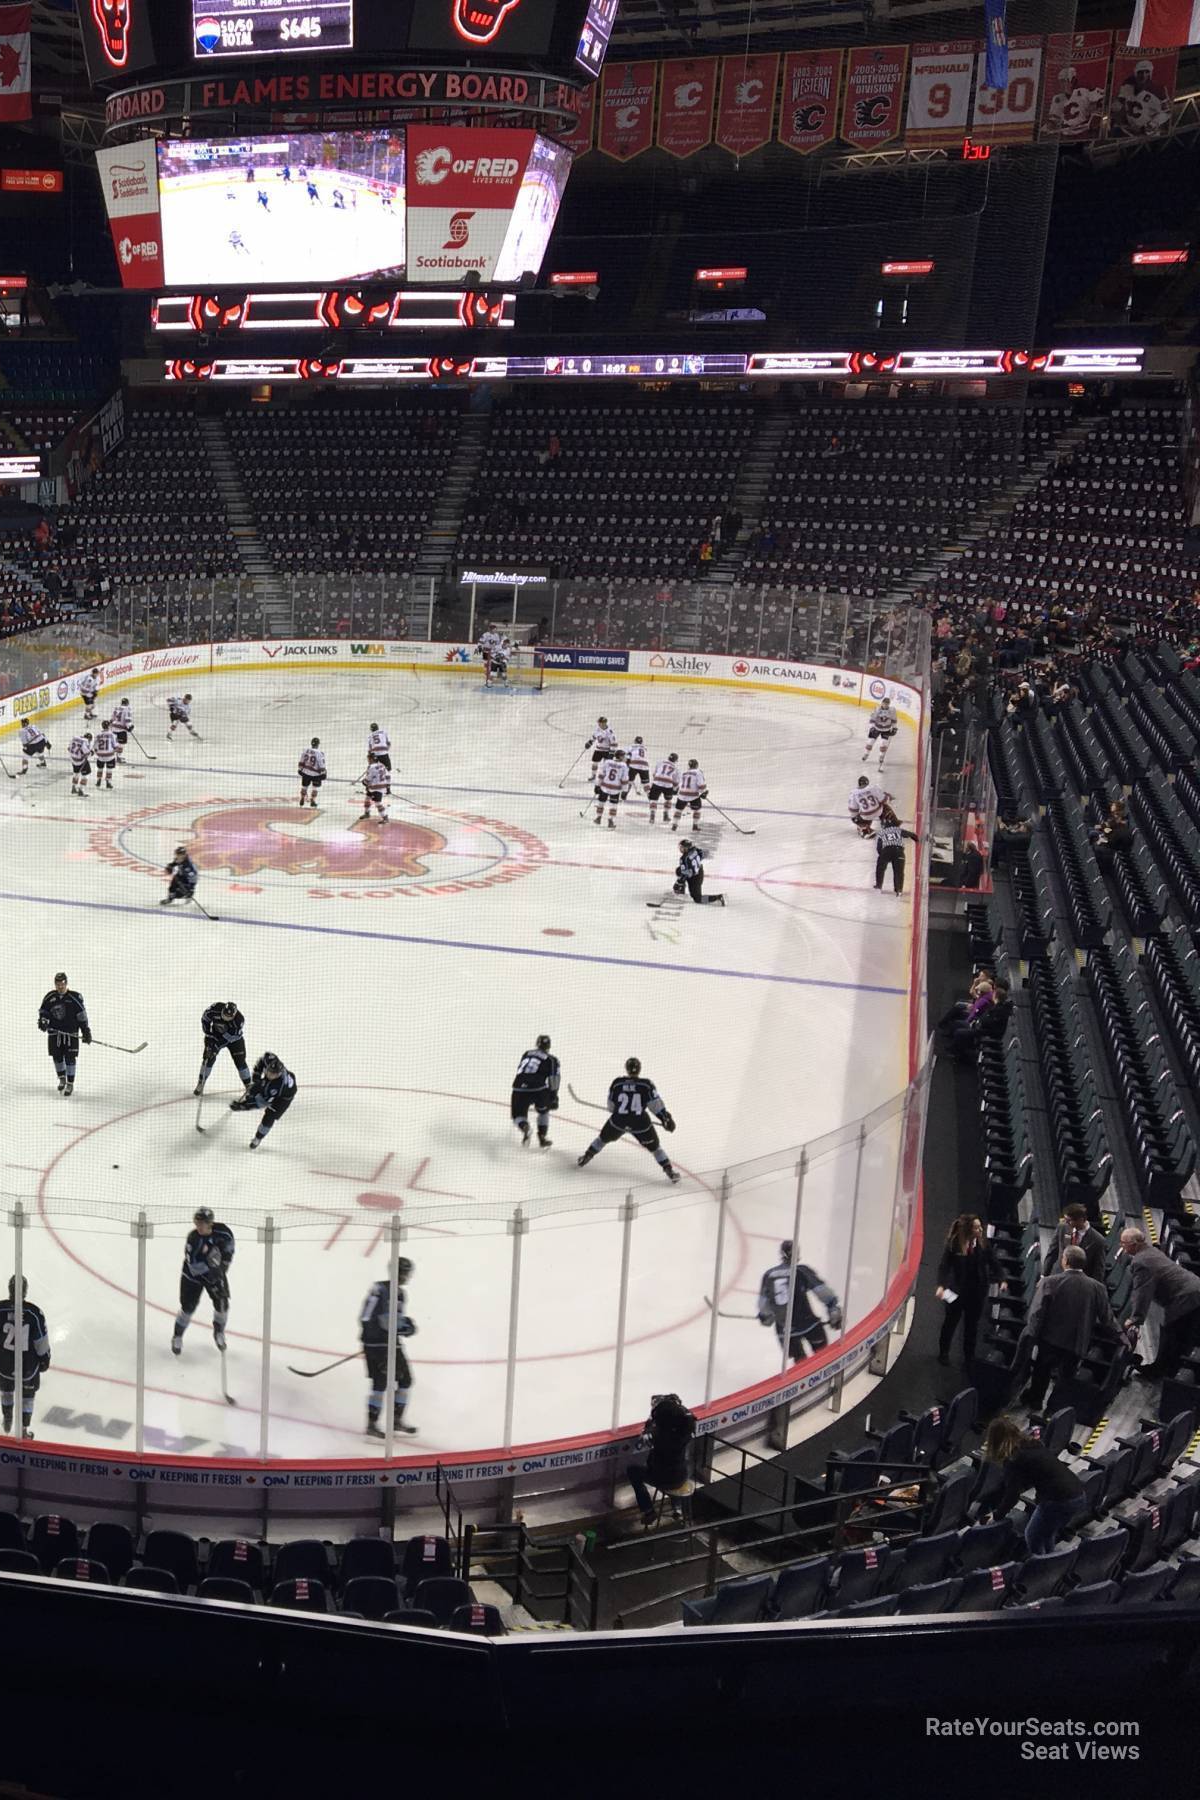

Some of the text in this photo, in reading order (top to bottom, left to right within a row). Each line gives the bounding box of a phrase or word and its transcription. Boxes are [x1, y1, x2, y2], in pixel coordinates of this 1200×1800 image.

[220, 19, 254, 32] 50/50
[280, 16, 322, 40] $645
[222, 32, 253, 47] TOTAL
[1075, 35, 1086, 47] 2
[850, 72, 902, 85] NORTHWEST
[202, 72, 528, 108] FLAMES ENERGY BOARD
[792, 76, 831, 102] WESTERN
[855, 83, 895, 95] DIVISION
[977, 77, 1035, 115] 30
[116, 88, 166, 121] BOARD
[927, 82, 952, 118] 9
[849, 129, 891, 138] CHAMPIONS
[452, 159, 475, 173] OF
[474, 157, 519, 177] RED
[141, 241, 158, 256] RED
[416, 255, 486, 269] Scotiabank
[582, 359, 591, 372] 0
[655, 358, 664, 371] 0
[460, 571, 547, 585] HitmenHockey.com
[283, 646, 307, 656] JACK
[141, 651, 199, 672] Budweiser
[578, 655, 607, 665] EVERYDAY
[607, 656, 626, 666] SAVES
[665, 656, 712, 674] Ashley
[752, 666, 817, 682] AIR CANADA
[13, 691, 37, 717] PIZZA
[98, 739, 110, 750] 21
[372, 734, 380, 744] 5
[303, 755, 317, 767] 29
[608, 768, 617, 781] 6
[682, 776, 692, 789] 11
[858, 796, 877, 810] 33
[887, 832, 896, 841] 21
[306, 864, 543, 899] Scotiabank
[617, 1092, 643, 1116] 24
[2, 1322, 30, 1352] 21
[751, 1398, 775, 1415] KEEPING
[775, 1395, 782, 1405] IT
[782, 1387, 799, 1403] FRESH
[698, 1418, 719, 1433] FRESH
[550, 1452, 585, 1467] KEEPING
[585, 1450, 594, 1462] IT
[596, 1446, 619, 1461] FRESH
[29, 1456, 66, 1471] KEEPING
[69, 1461, 77, 1472] IT
[79, 1462, 108, 1477] FRESH
[426, 1468, 464, 1482] KEEPING
[465, 1467, 474, 1479] IT
[476, 1465, 504, 1478] FRESH
[160, 1470, 199, 1484] KEEPING
[201, 1473, 210, 1484] IT
[212, 1473, 242, 1485] FRESH
[294, 1475, 333, 1486] KEEPING
[335, 1475, 344, 1486] IT
[347, 1474, 375, 1485] FRESH
